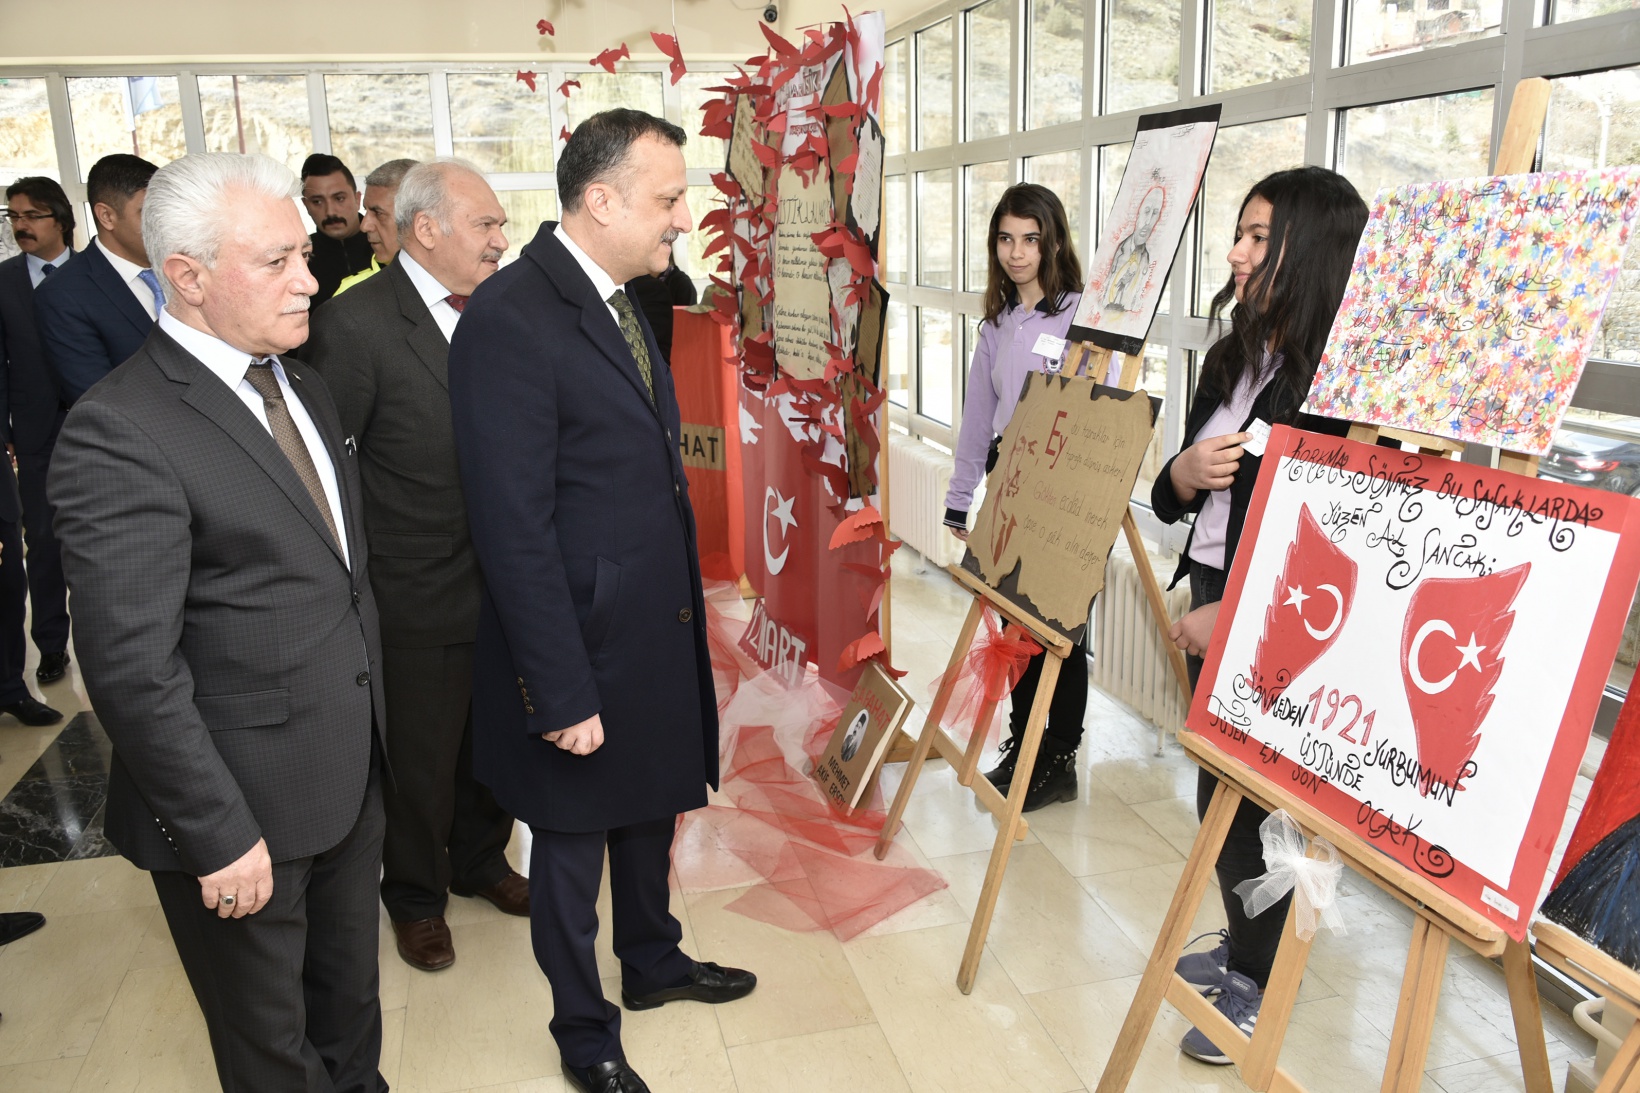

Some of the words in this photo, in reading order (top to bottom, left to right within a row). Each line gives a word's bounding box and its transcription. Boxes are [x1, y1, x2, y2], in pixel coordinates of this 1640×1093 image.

[1045, 410, 1068, 470] Ey
[1352, 454, 1430, 523] SÖNMEZ
[1436, 472, 1463, 505] BU
[1366, 519, 1408, 558] AL
[1308, 685, 1376, 747] 1921
[827, 755, 850, 791] MEHMET
[1259, 742, 1284, 765] EN
[1291, 764, 1328, 795] SON
[1300, 732, 1365, 791] ÜSTÜNDE
